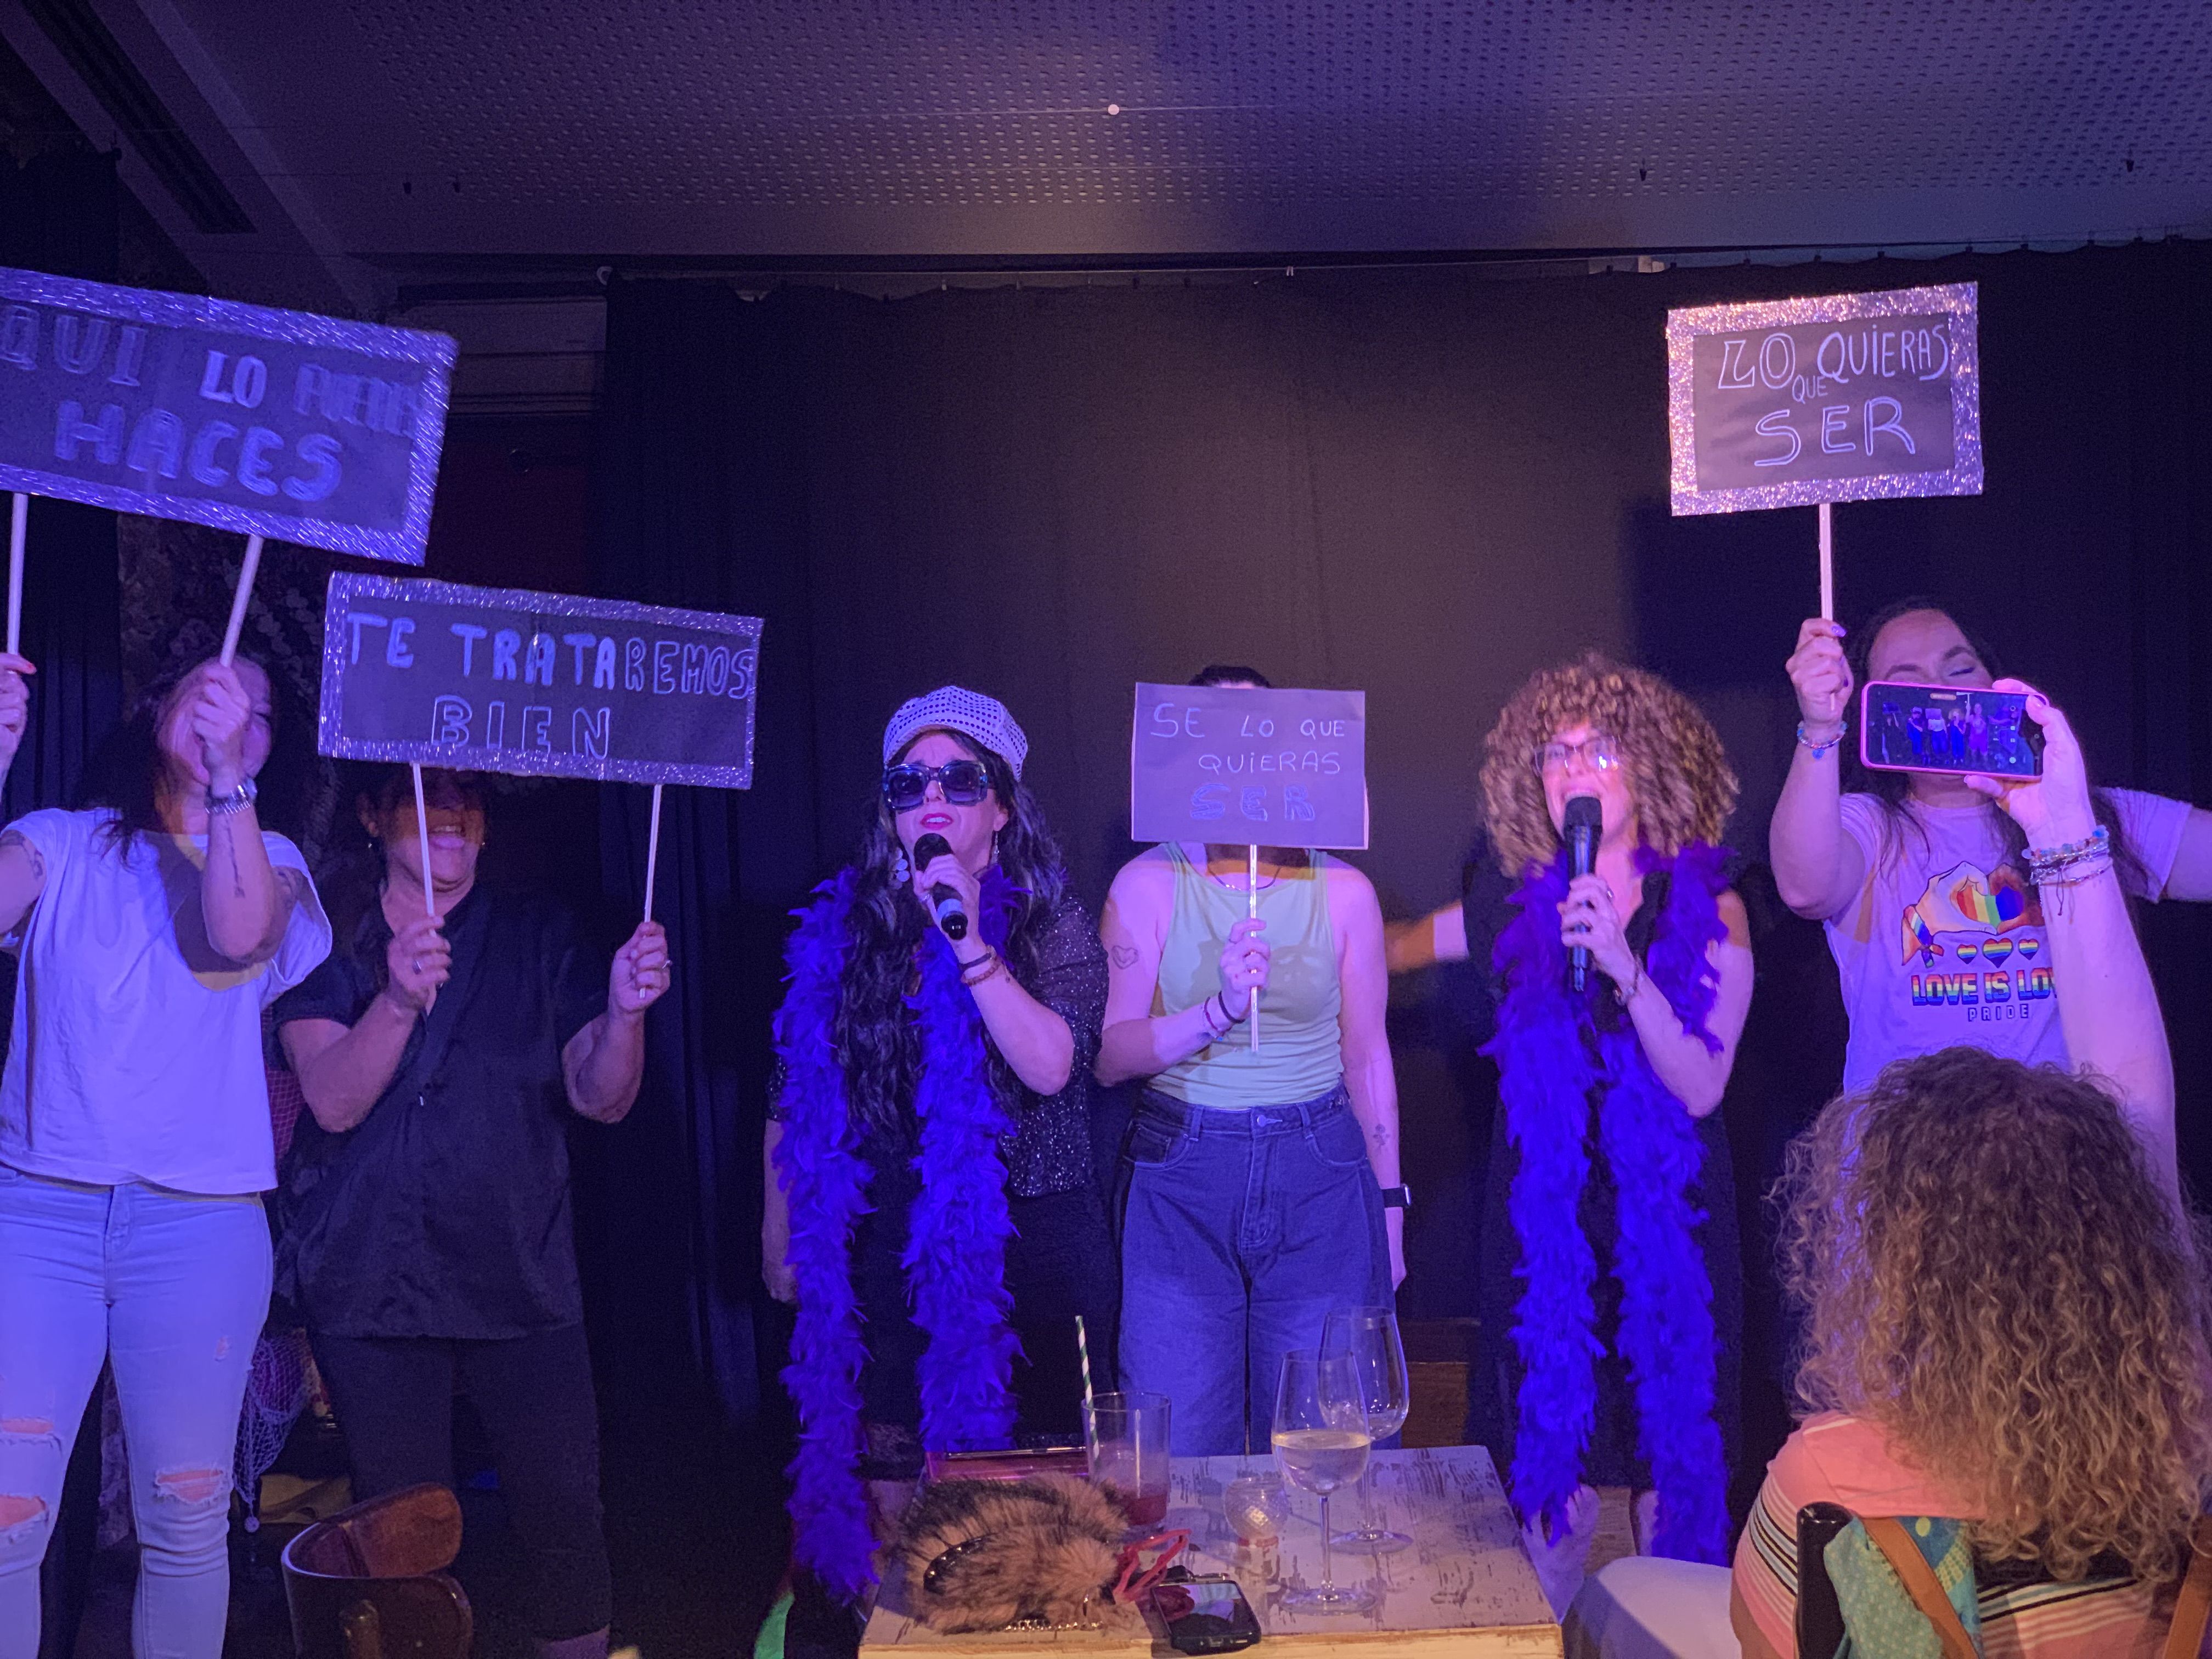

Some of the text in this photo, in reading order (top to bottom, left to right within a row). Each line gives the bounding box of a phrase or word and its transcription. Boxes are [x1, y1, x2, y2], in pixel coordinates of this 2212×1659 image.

[200, 349, 268, 408] LO
[1718, 332, 1796, 389] LO
[1792, 373, 1829, 403] QUE
[54, 400, 343, 501] HACES
[1754, 396, 1915, 466] SER
[346, 612, 755, 699] TE TRATAREMOS
[431, 695, 610, 760] BIEN
[1150, 703, 1345, 740] SE LO QUE
[1189, 783, 1316, 821] SER
[1911, 967, 2057, 1006] LOVE IS LO
[1967, 1003, 2029, 1022] PRIDE
